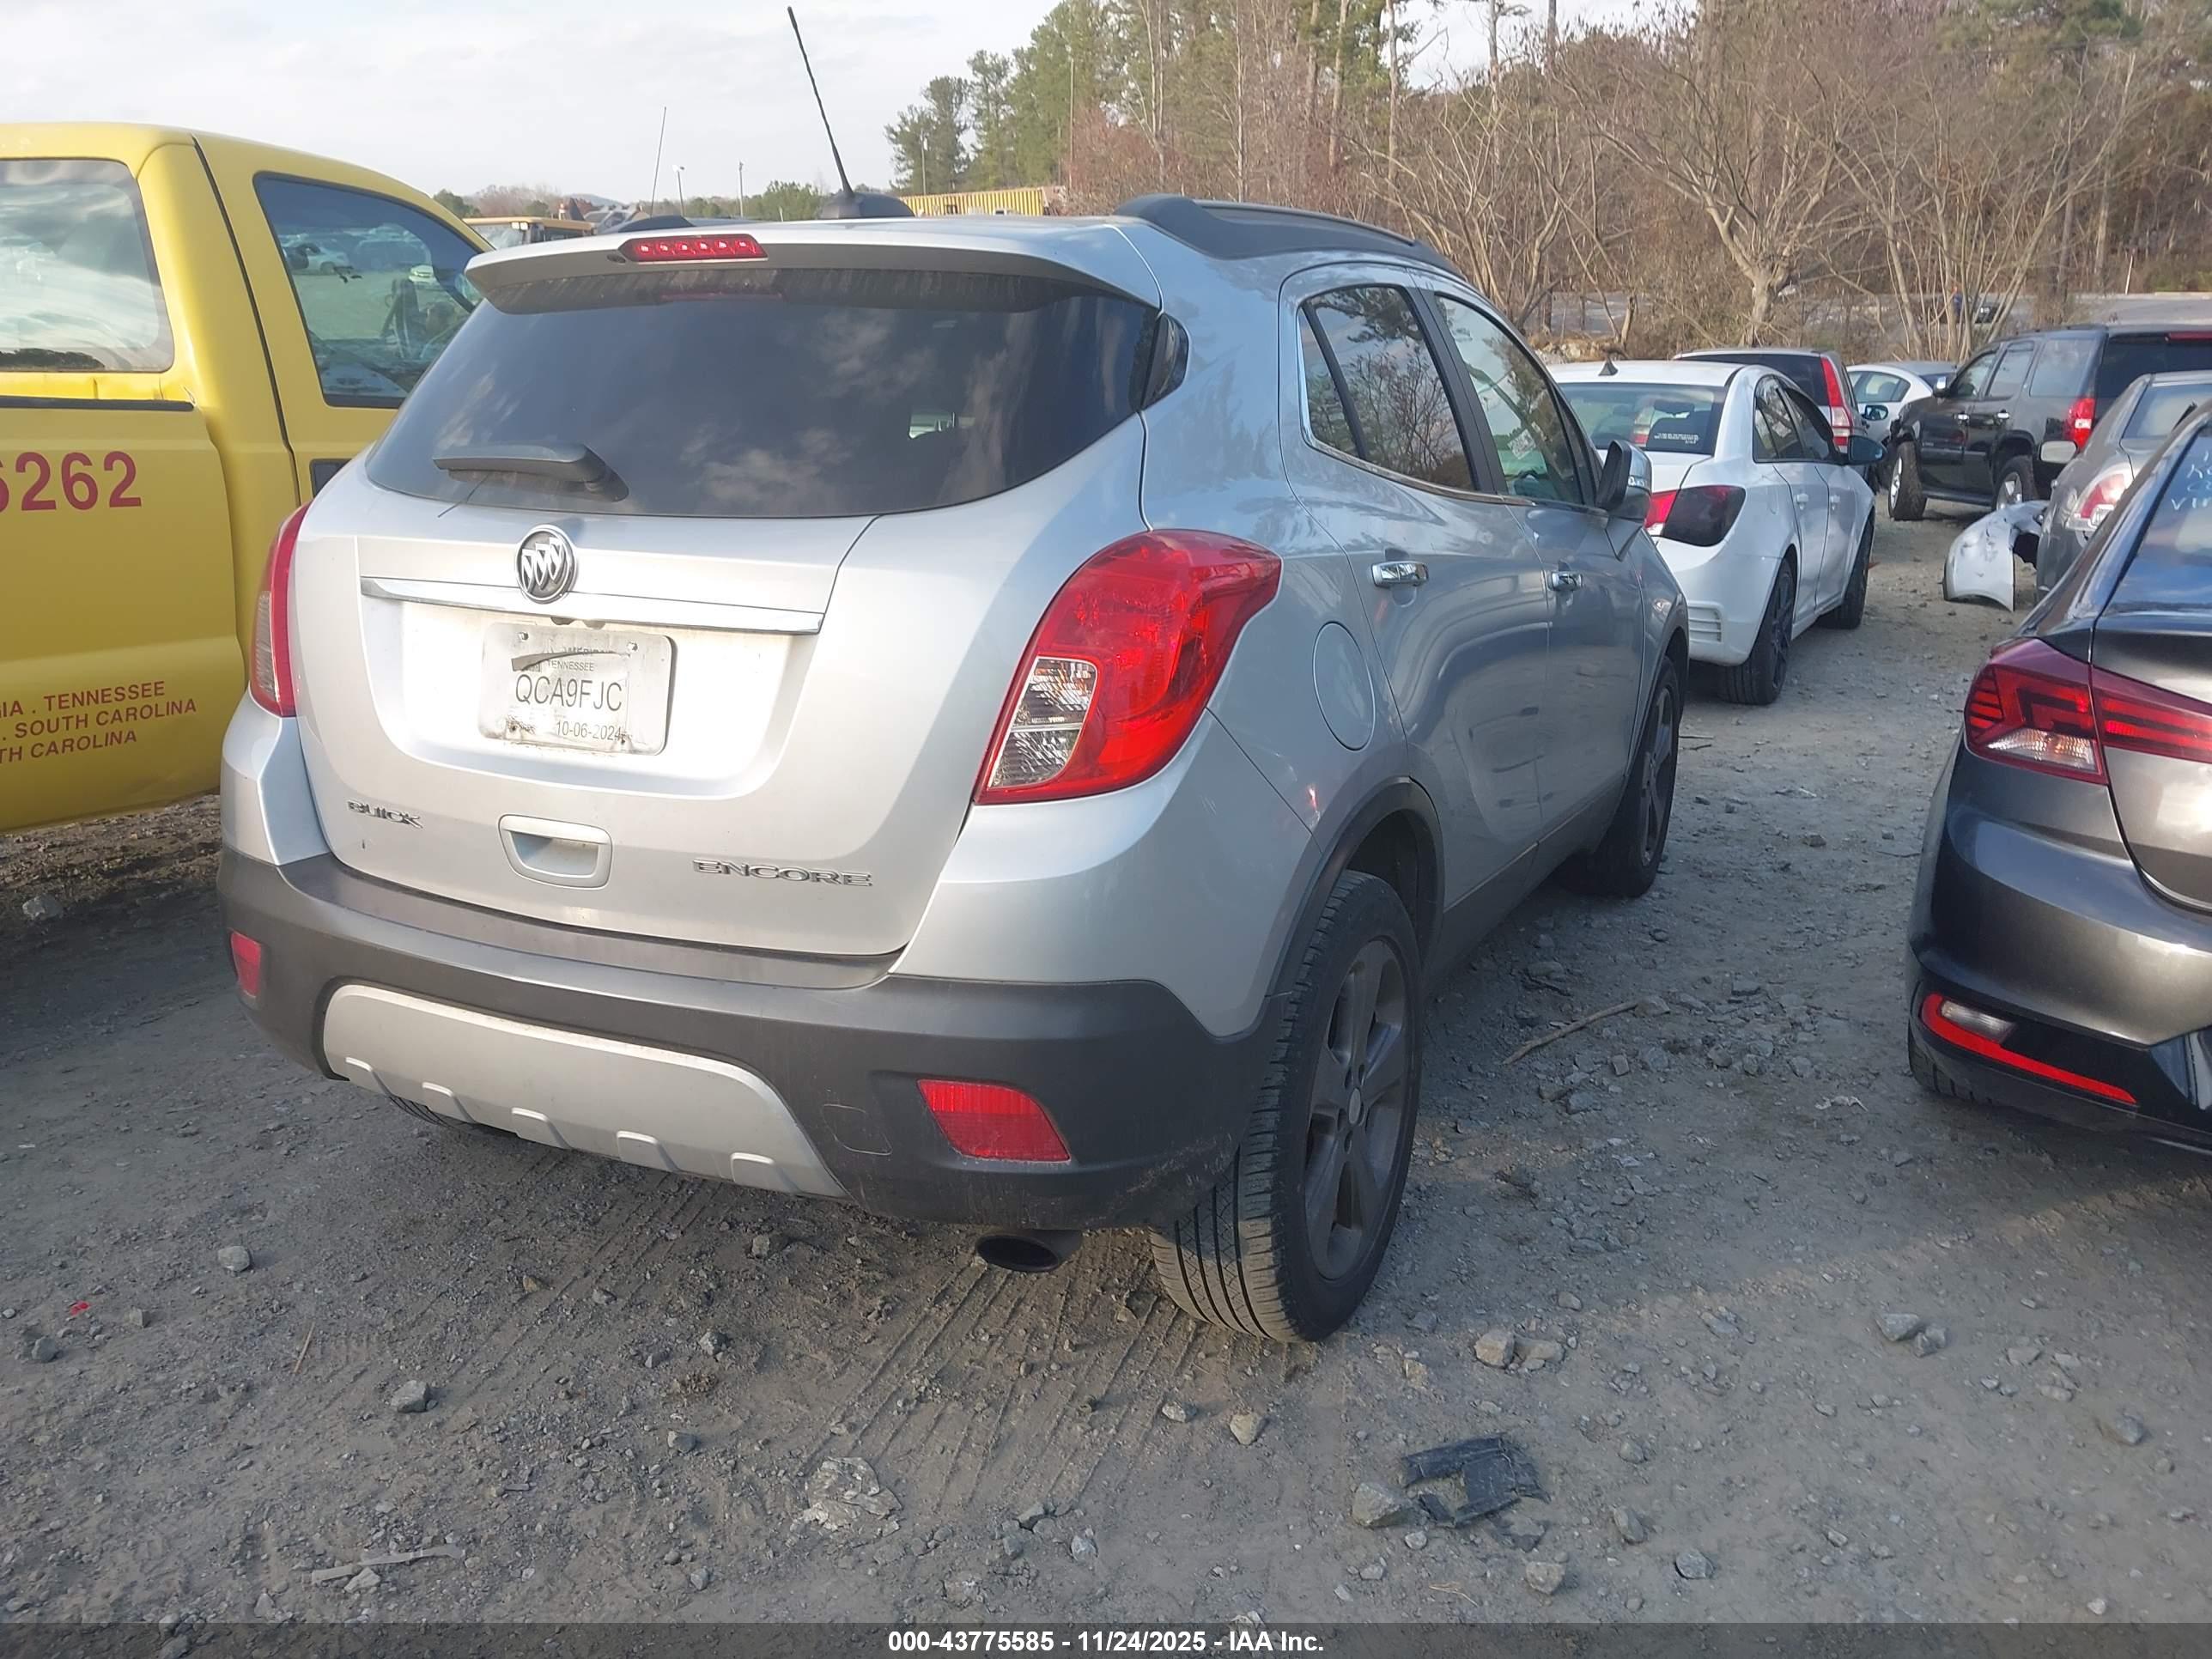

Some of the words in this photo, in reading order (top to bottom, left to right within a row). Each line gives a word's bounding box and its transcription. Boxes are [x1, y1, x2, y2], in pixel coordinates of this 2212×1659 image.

[0, 451, 143, 513] 262
[548, 659, 595, 672] TENNESSEE
[0, 700, 24, 720] IA
[44, 680, 165, 711] TENNESSEE
[515, 674, 622, 711] QCA9FJC
[15, 713, 88, 739] SOUTH
[95, 698, 197, 726] CAROLINA
[556, 720, 622, 741] 10-06-2024
[30, 730, 137, 758] CAROLINA
[346, 799, 422, 829] BUICK
[692, 858, 873, 887] ENCORE
